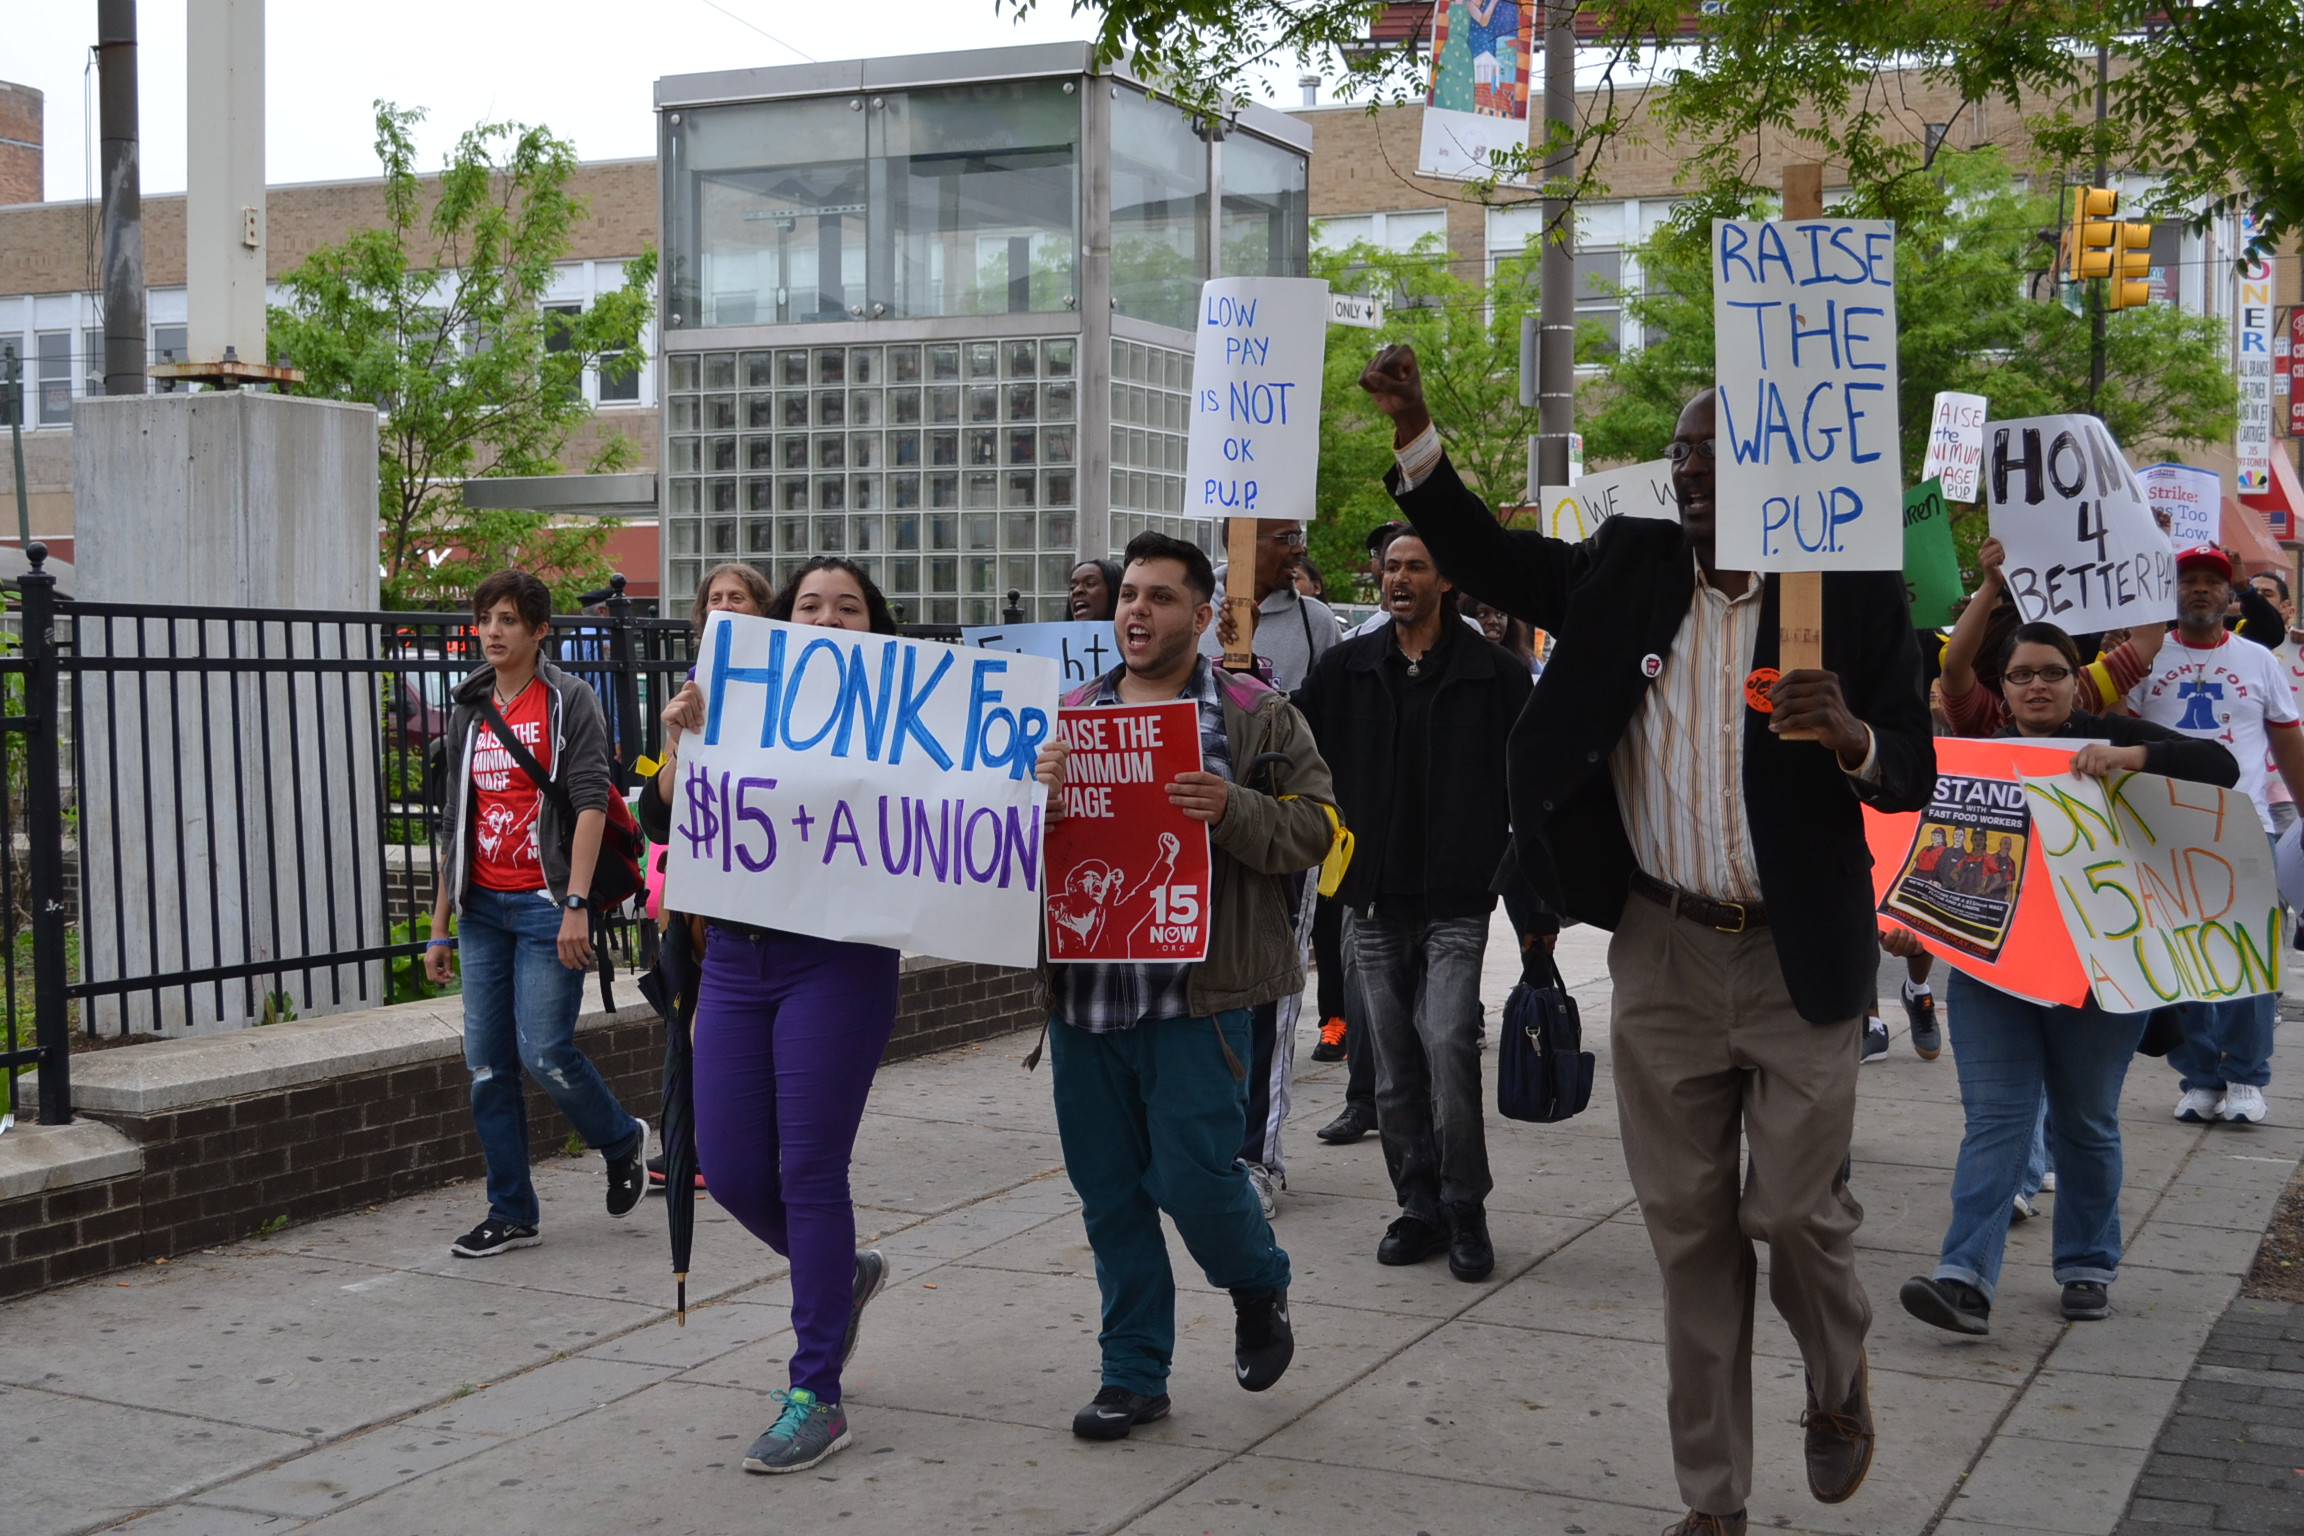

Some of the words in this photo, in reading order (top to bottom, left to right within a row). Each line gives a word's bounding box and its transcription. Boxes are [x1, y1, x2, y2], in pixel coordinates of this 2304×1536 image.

[1720, 222, 1892, 287] RAISE
[1207, 296, 1257, 328] LOW
[1334, 301, 1361, 319] ONLY
[1226, 336, 1269, 366] PAY
[1726, 299, 1887, 371] THE
[1200, 389, 1220, 413] IS
[1230, 380, 1295, 426] NOT
[2250, 382, 2266, 399] TONER
[1719, 378, 1885, 466] WAGE
[1934, 402, 1983, 428] AISE
[1223, 437, 1255, 463] OK
[1934, 426, 1959, 444] the
[1582, 484, 1625, 524] WE
[2148, 485, 2199, 503] Strike:
[2177, 504, 2208, 523] Too
[2077, 499, 2109, 562] 4
[2174, 522, 2209, 541] Low
[2009, 553, 2154, 623] BETTER
[2155, 551, 2177, 603] PA
[2151, 663, 2206, 697] FIGHT
[2214, 665, 2249, 699] FOR
[704, 619, 955, 772] HONK
[961, 659, 1049, 781] FOR
[474, 731, 505, 752] RAIS
[511, 722, 541, 743] THE
[1057, 717, 1109, 750] AISE
[1112, 715, 1164, 749] THE
[1063, 751, 1154, 783] INIMUM
[1933, 777, 2027, 809] STAND
[1928, 808, 1951, 820] FAST
[1952, 811, 1977, 823] FOOD
[1979, 815, 2023, 828] WORKERS
[1966, 805, 1987, 814] WITH
[2165, 777, 2225, 843] 4
[677, 760, 778, 872] $15
[791, 804, 815, 842] +
[822, 800, 868, 866] A
[878, 795, 1040, 892] UNION
[1149, 884, 1199, 924] 15
[2060, 859, 2144, 940] 15
[2134, 847, 2235, 930] AND
[1149, 925, 1198, 944] NOW
[2089, 953, 2135, 1009] A
[2132, 906, 2282, 1002] UNION
